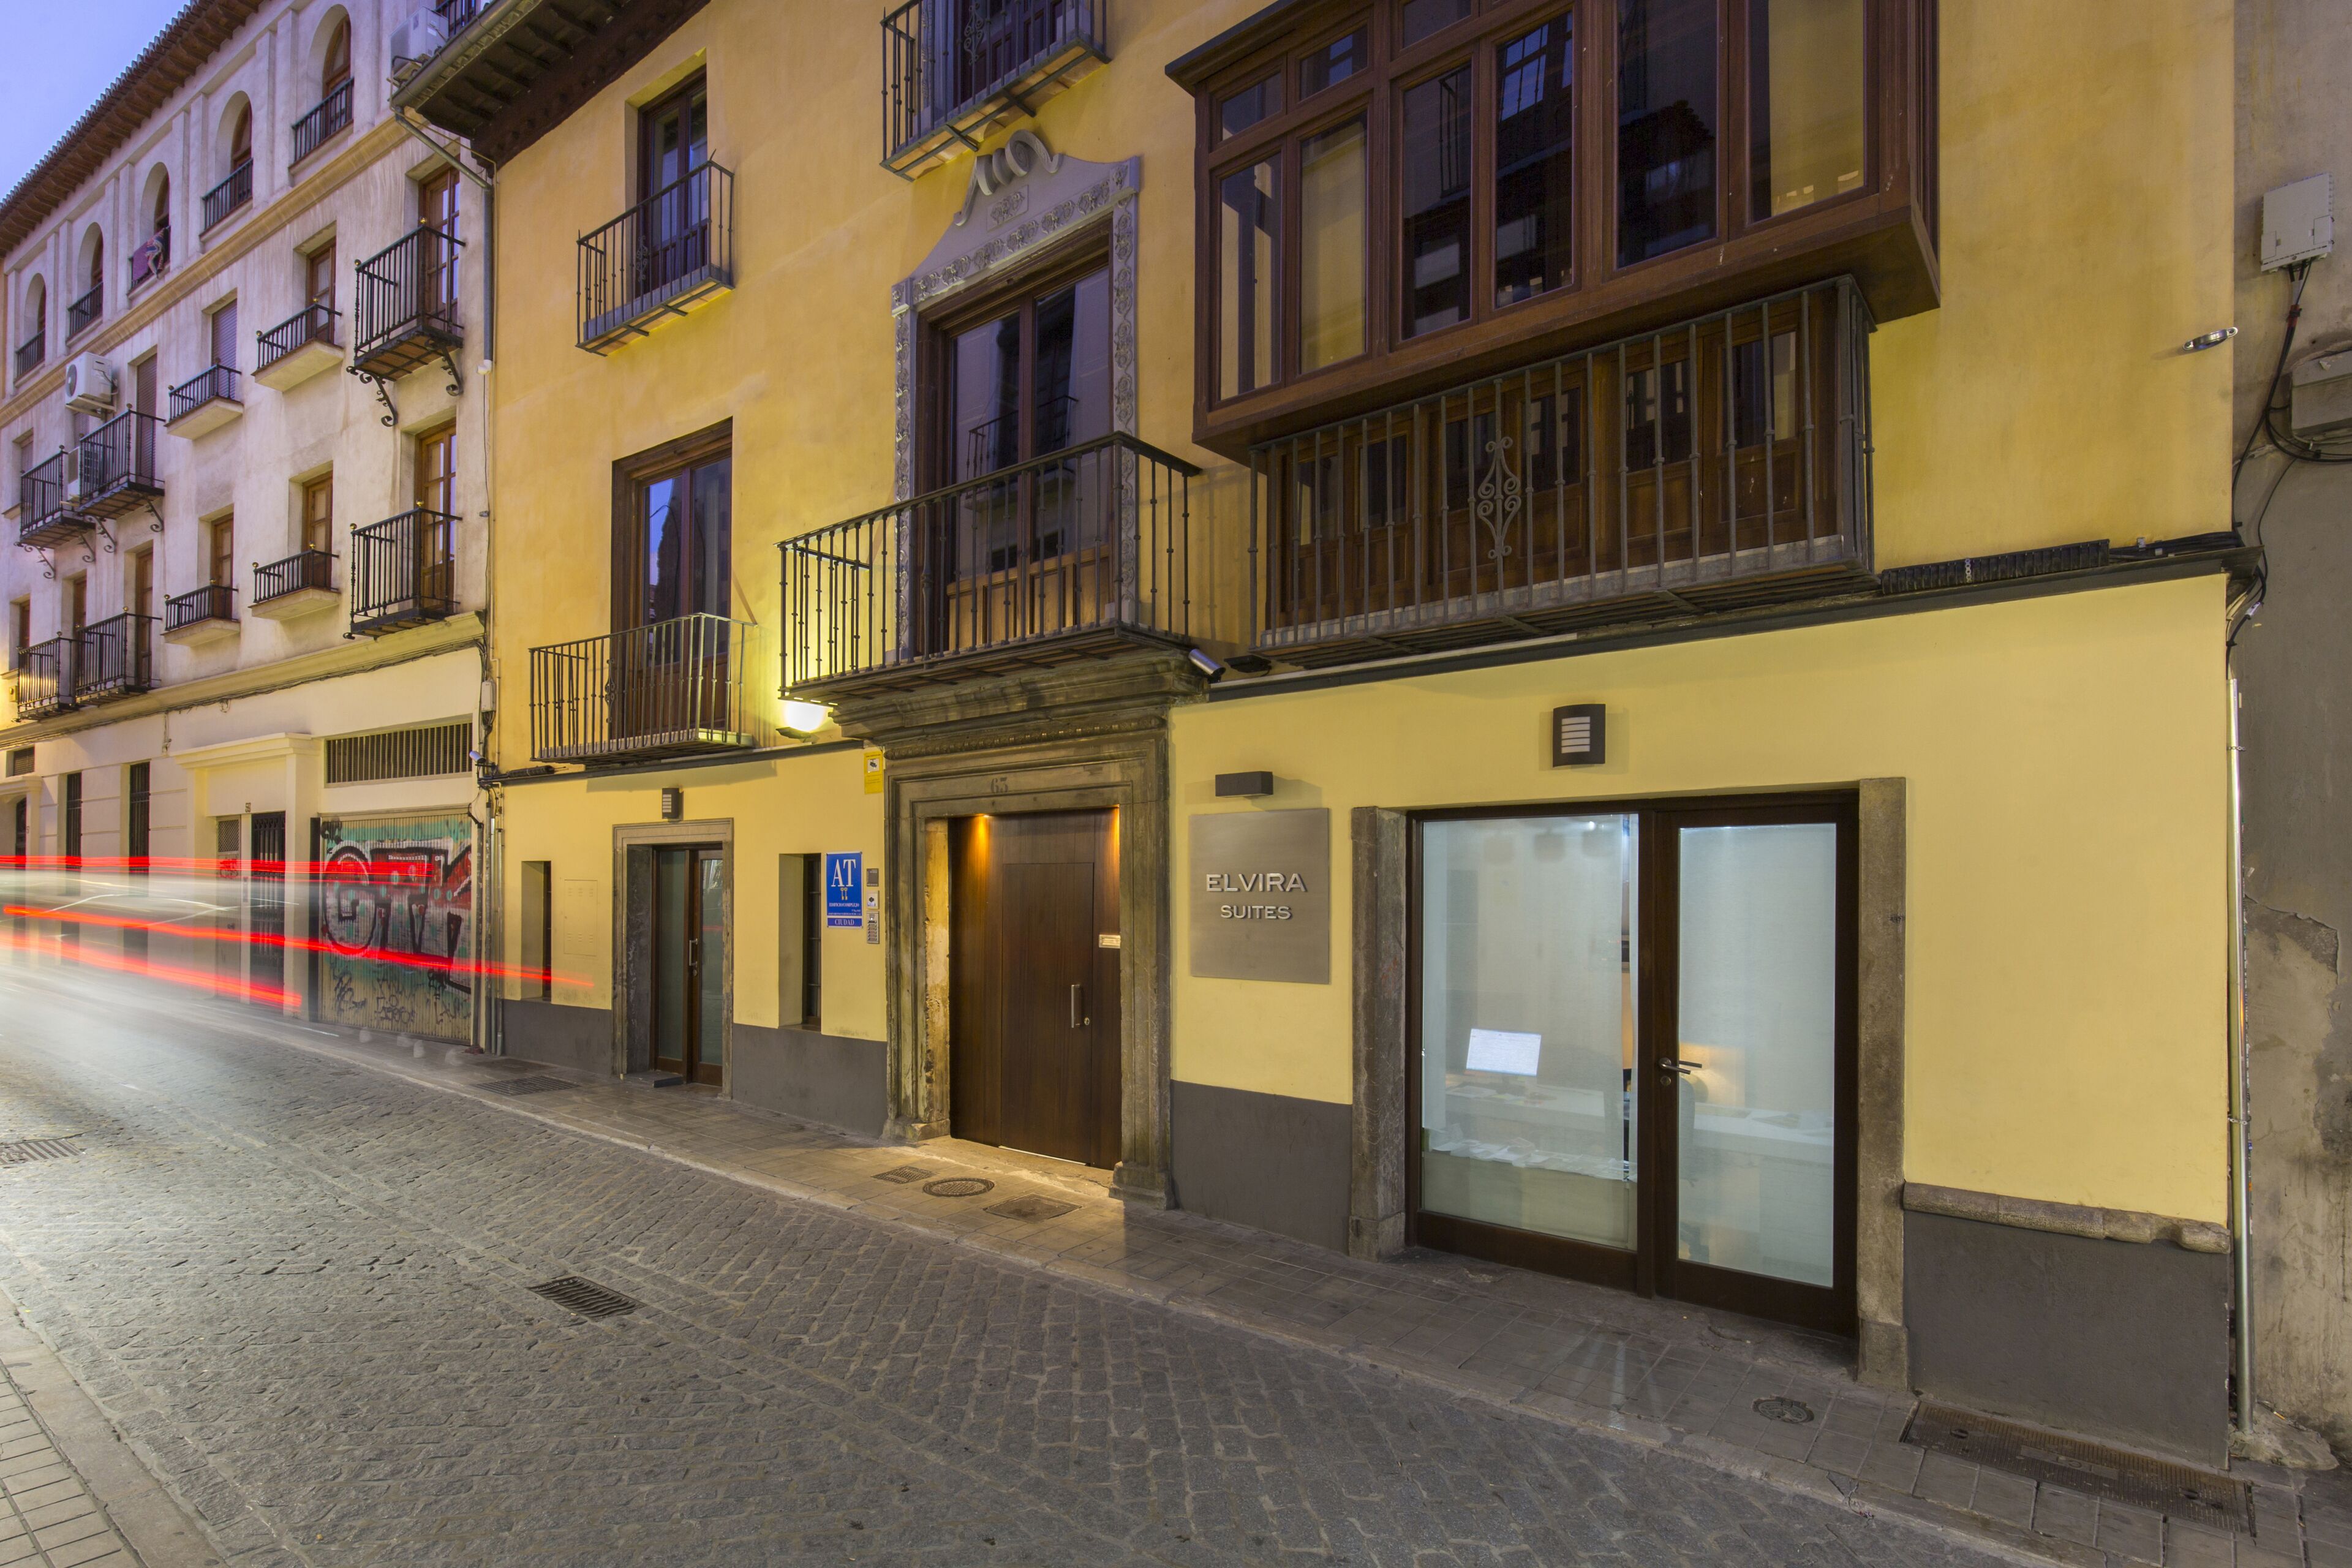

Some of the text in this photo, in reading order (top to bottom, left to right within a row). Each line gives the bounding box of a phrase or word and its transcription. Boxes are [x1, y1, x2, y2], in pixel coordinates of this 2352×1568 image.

[831, 859, 856, 887] AT
[1206, 873, 1307, 892] ELVIRA
[1220, 905, 1292, 919] SUITES
